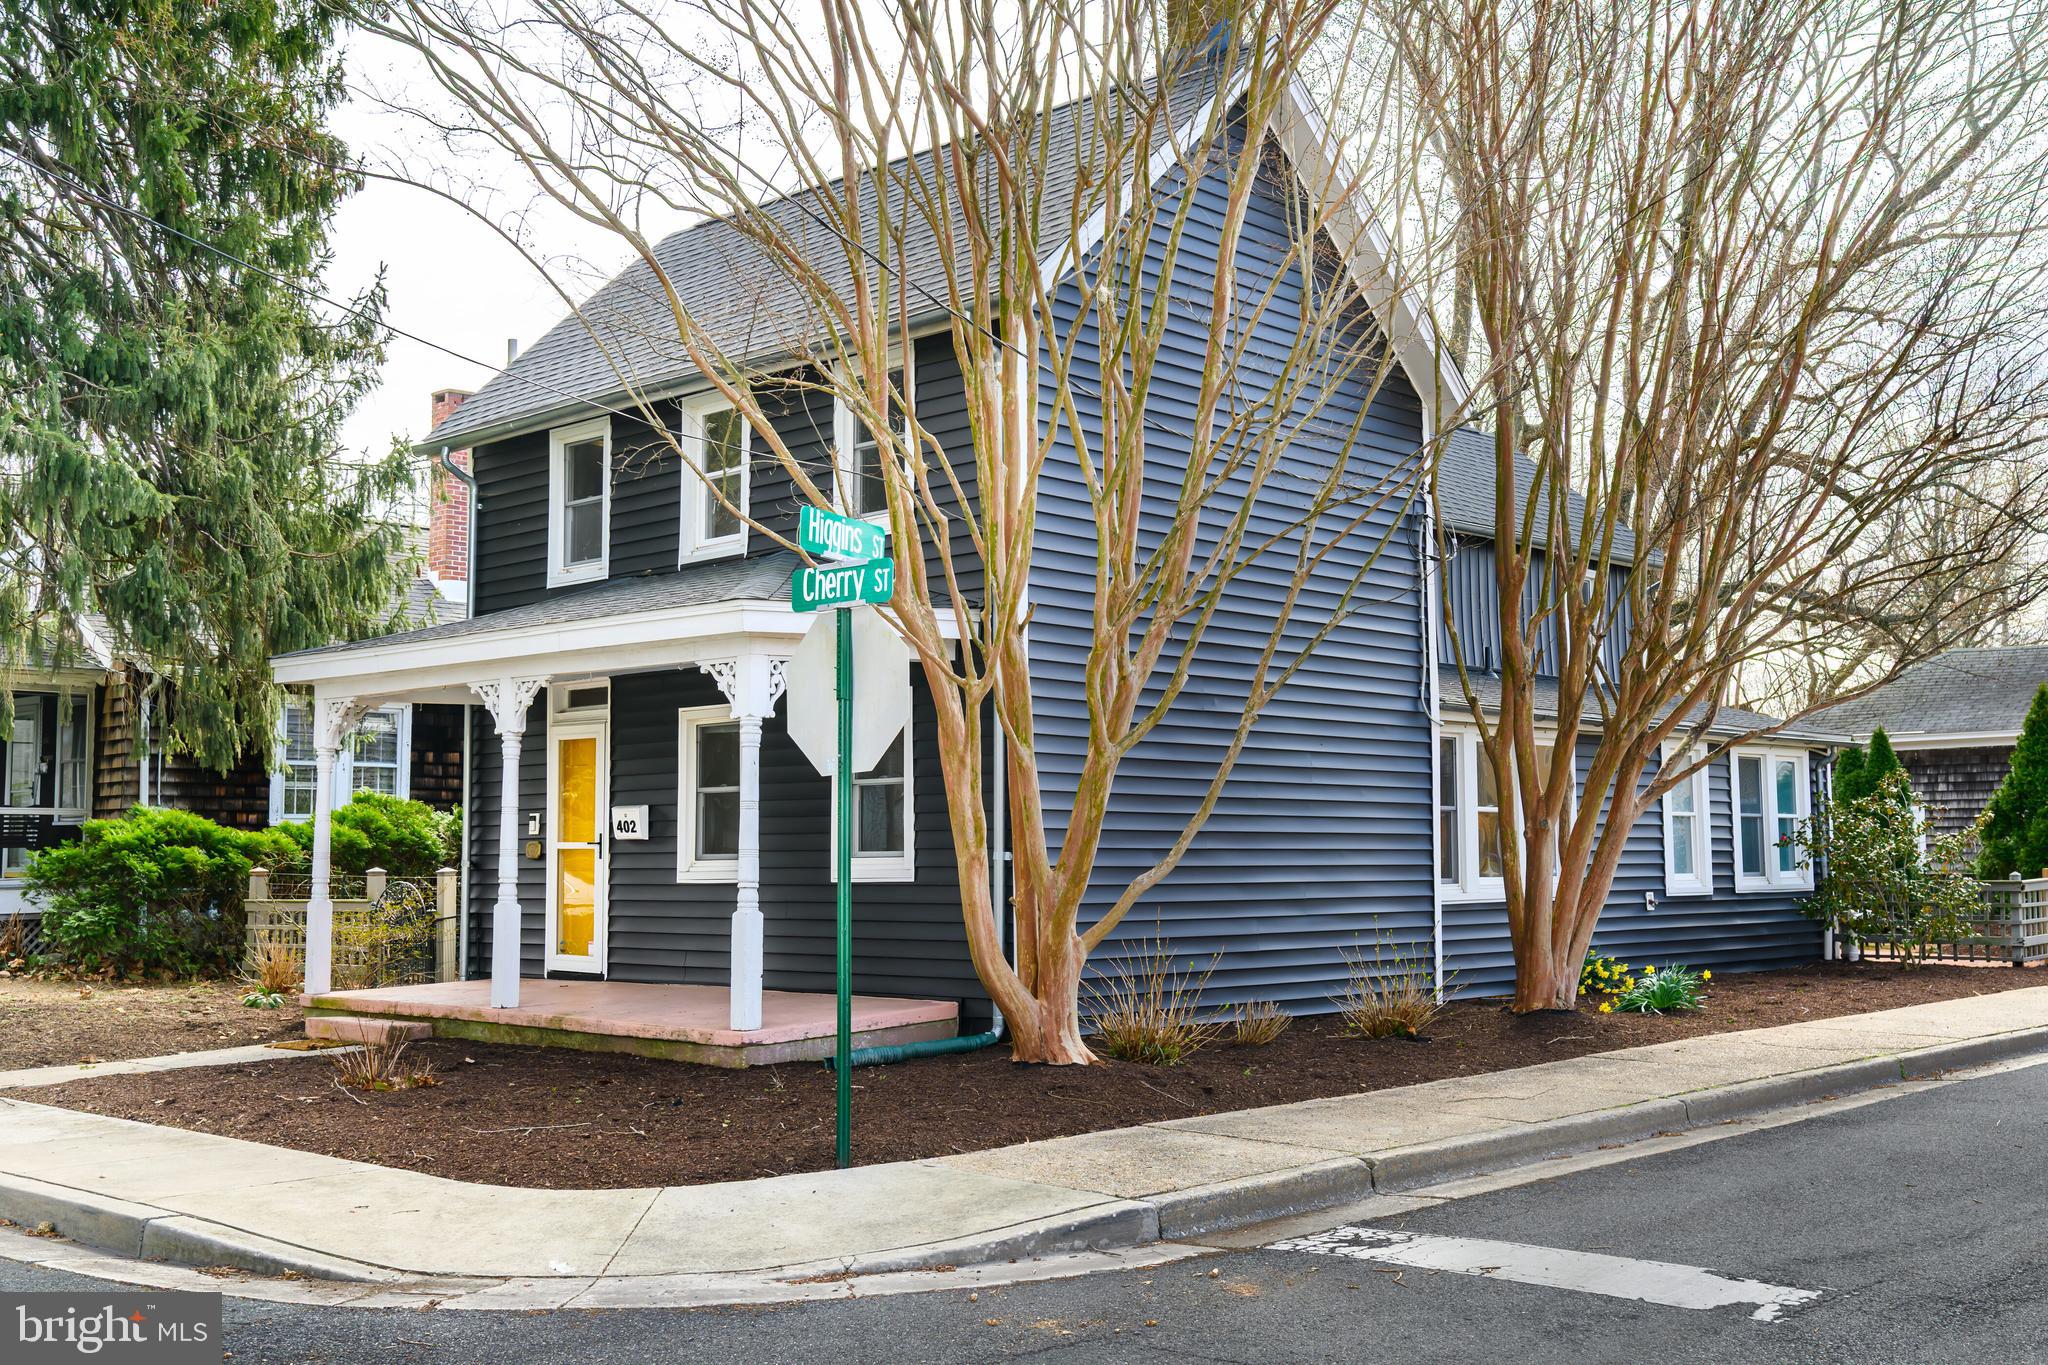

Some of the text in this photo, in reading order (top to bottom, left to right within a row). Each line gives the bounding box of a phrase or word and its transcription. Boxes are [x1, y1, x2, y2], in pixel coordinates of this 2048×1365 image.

[808, 507, 885, 559] Higgins ST
[803, 567, 890, 602] Cherry ST
[616, 820, 637, 833] 402
